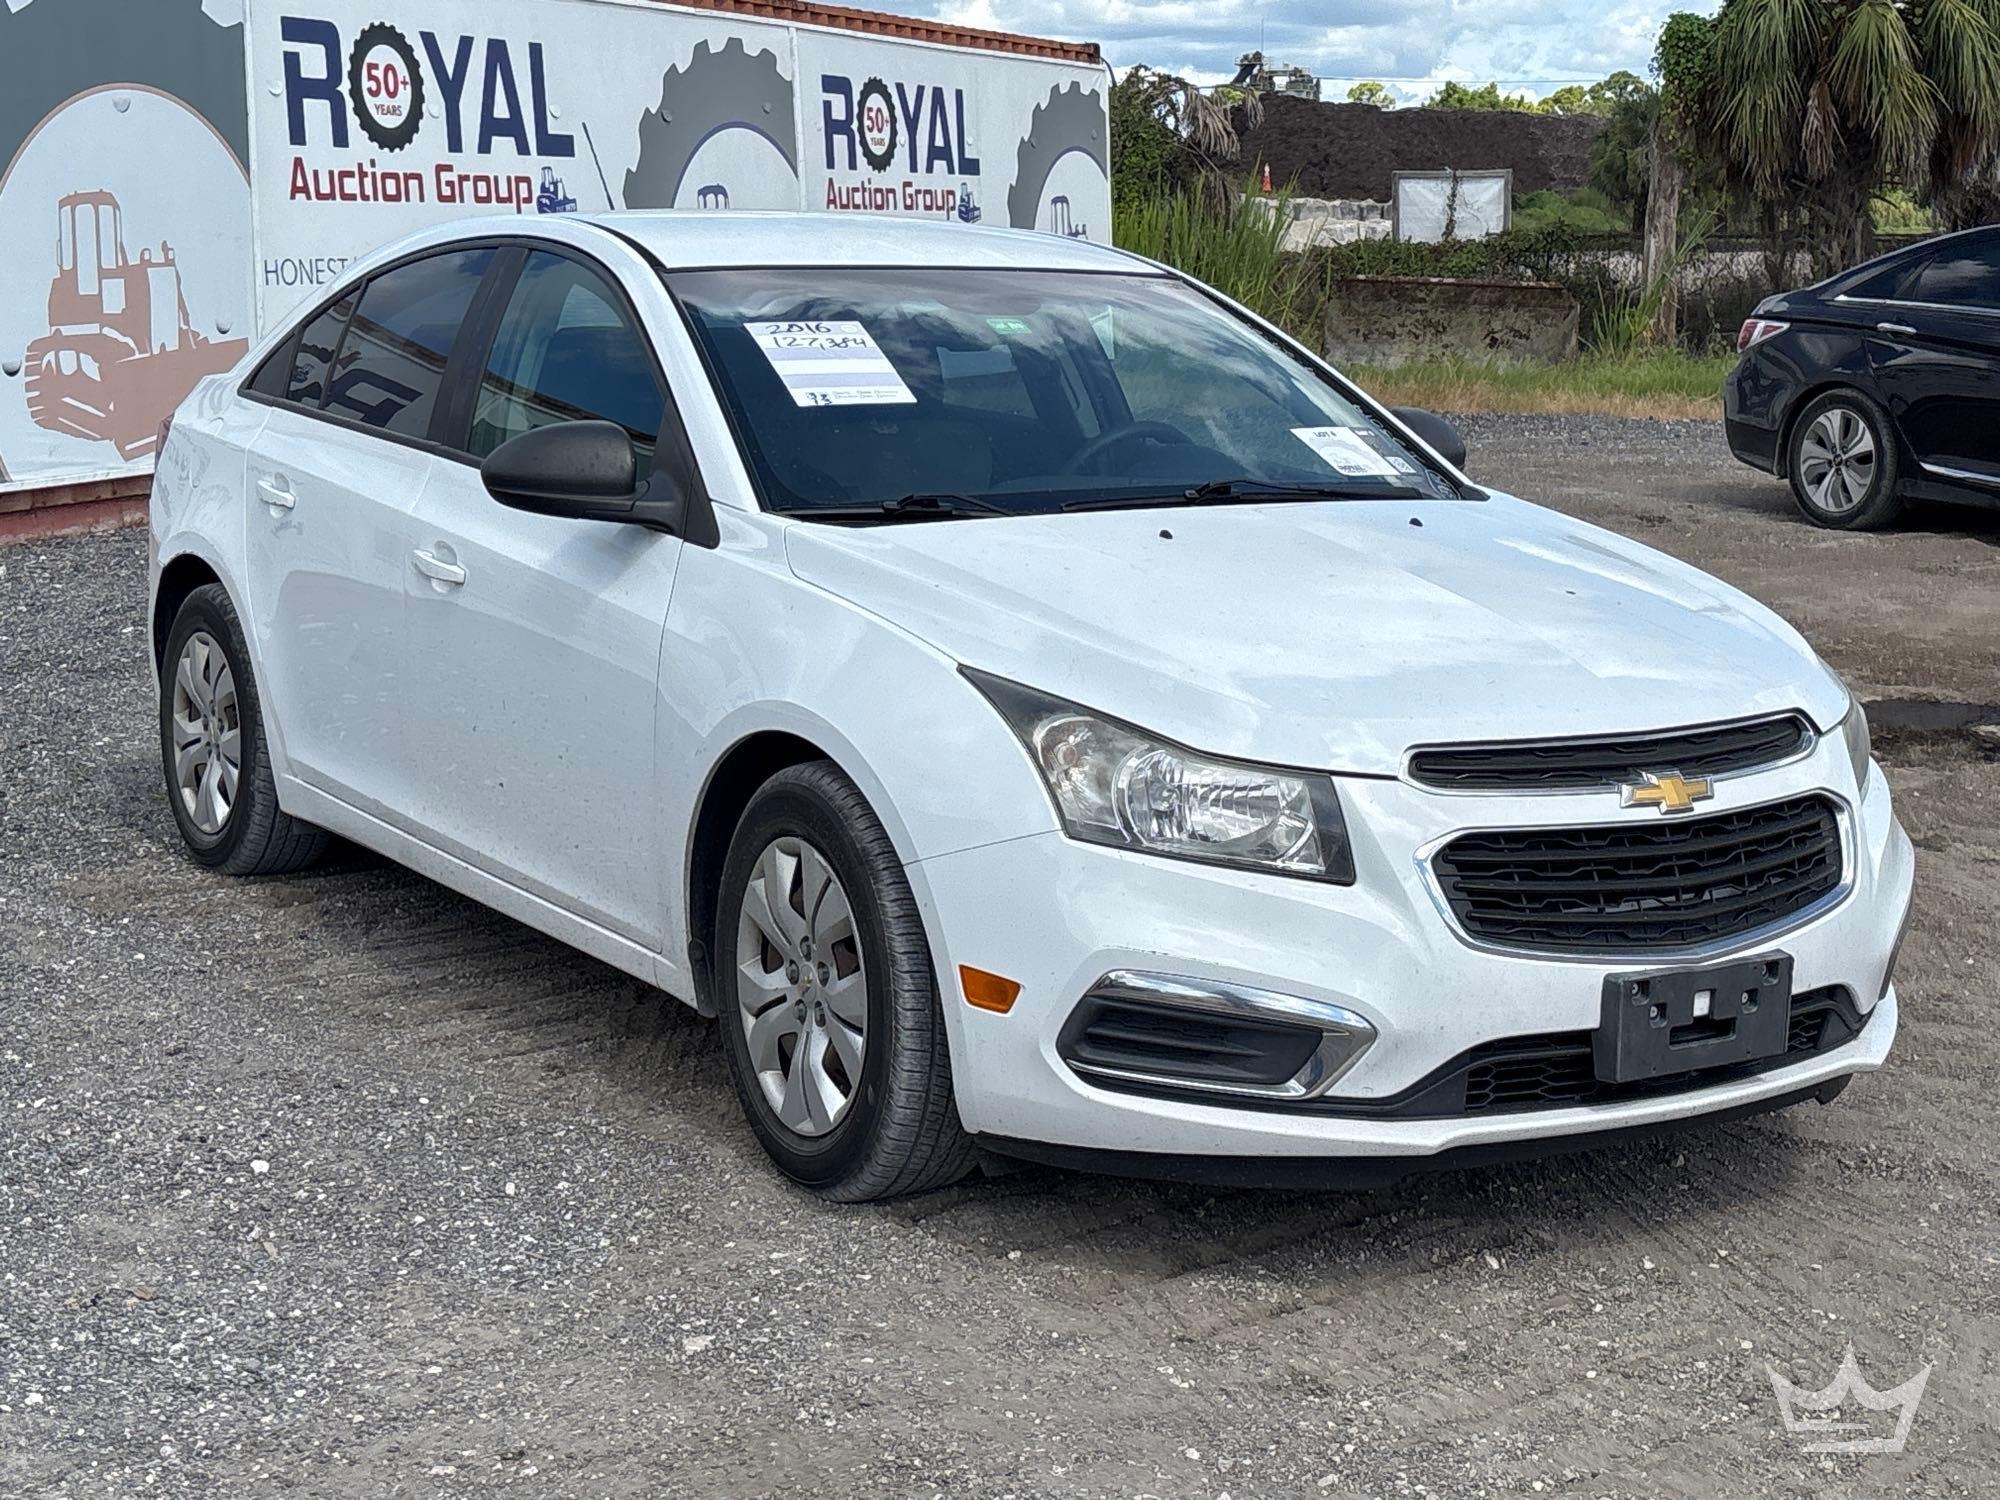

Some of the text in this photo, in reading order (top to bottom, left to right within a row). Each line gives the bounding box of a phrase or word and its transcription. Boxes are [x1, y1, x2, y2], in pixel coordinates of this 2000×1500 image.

[280, 16, 576, 158] ROYAL
[366, 62, 409, 99] 50+
[374, 103, 402, 117] YEARS
[821, 74, 981, 176] ROYAL
[866, 107, 890, 134] 50+
[870, 137, 886, 147] YEARS
[289, 156, 533, 214] Auction Group
[826, 177, 956, 221] Auction Group
[766, 322, 832, 334] 2016
